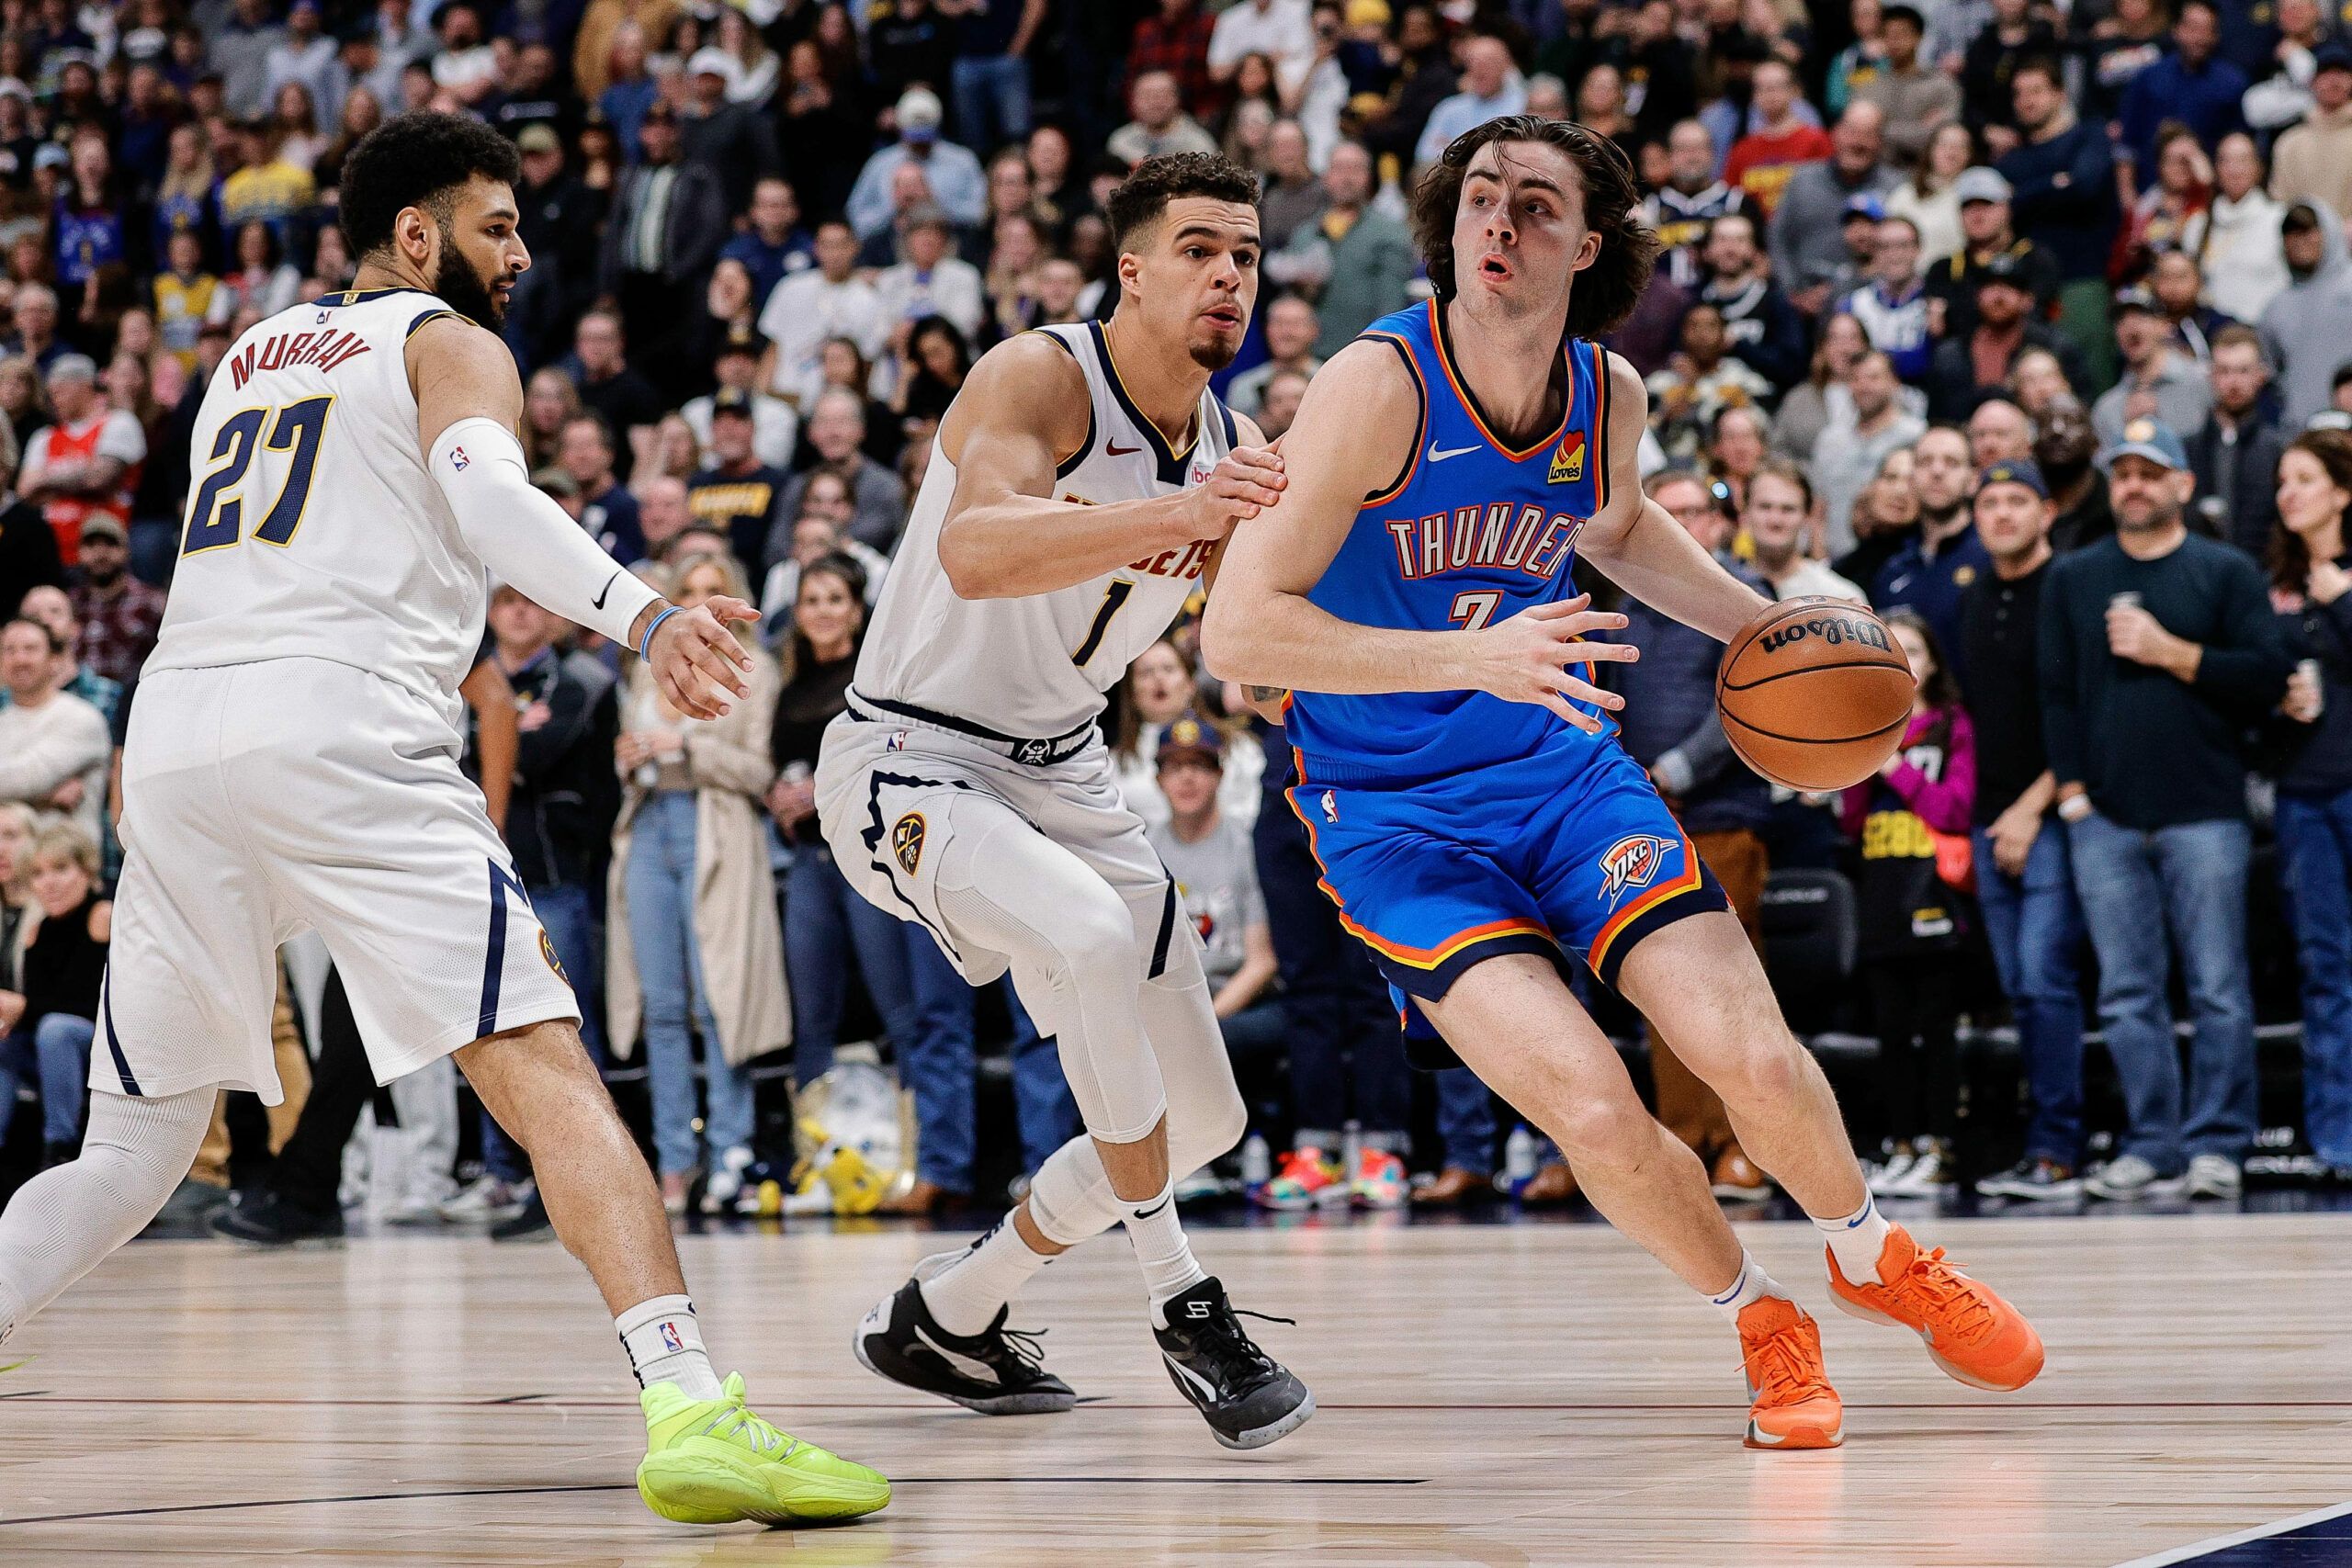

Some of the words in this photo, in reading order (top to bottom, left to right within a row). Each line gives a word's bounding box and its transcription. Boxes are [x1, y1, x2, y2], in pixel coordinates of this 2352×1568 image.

[231, 329, 371, 391] MURRAY
[181, 393, 337, 558] 27
[1385, 502, 1587, 580] THUNDER
[1071, 578, 1136, 668] 1
[1758, 617, 1894, 653] Wilson
[1612, 842, 1647, 891] OKC
